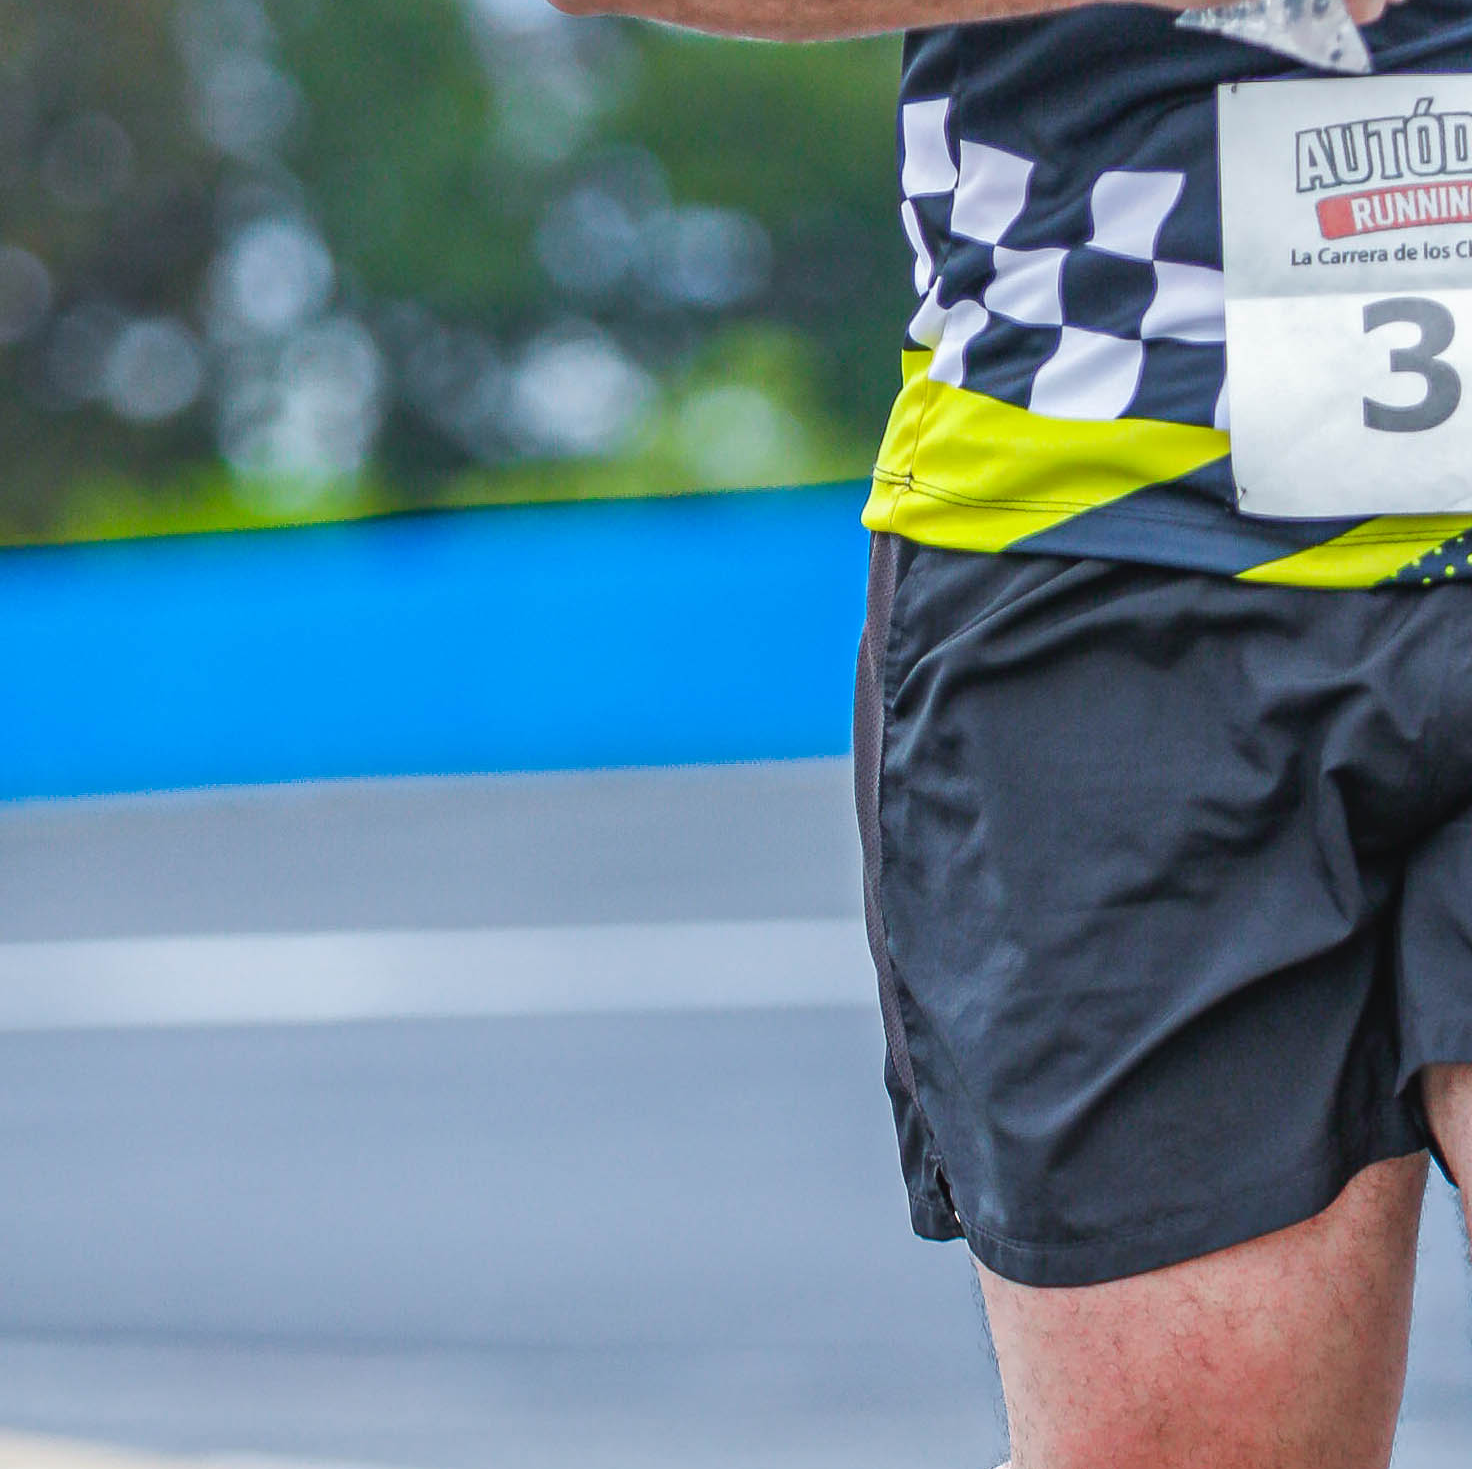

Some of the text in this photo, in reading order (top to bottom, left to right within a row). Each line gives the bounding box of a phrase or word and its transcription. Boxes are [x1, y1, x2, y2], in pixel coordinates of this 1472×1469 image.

[1291, 249, 1312, 266] La
[1317, 247, 1388, 265] Carrera
[1394, 243, 1417, 261] de
[1423, 242, 1450, 260] los
